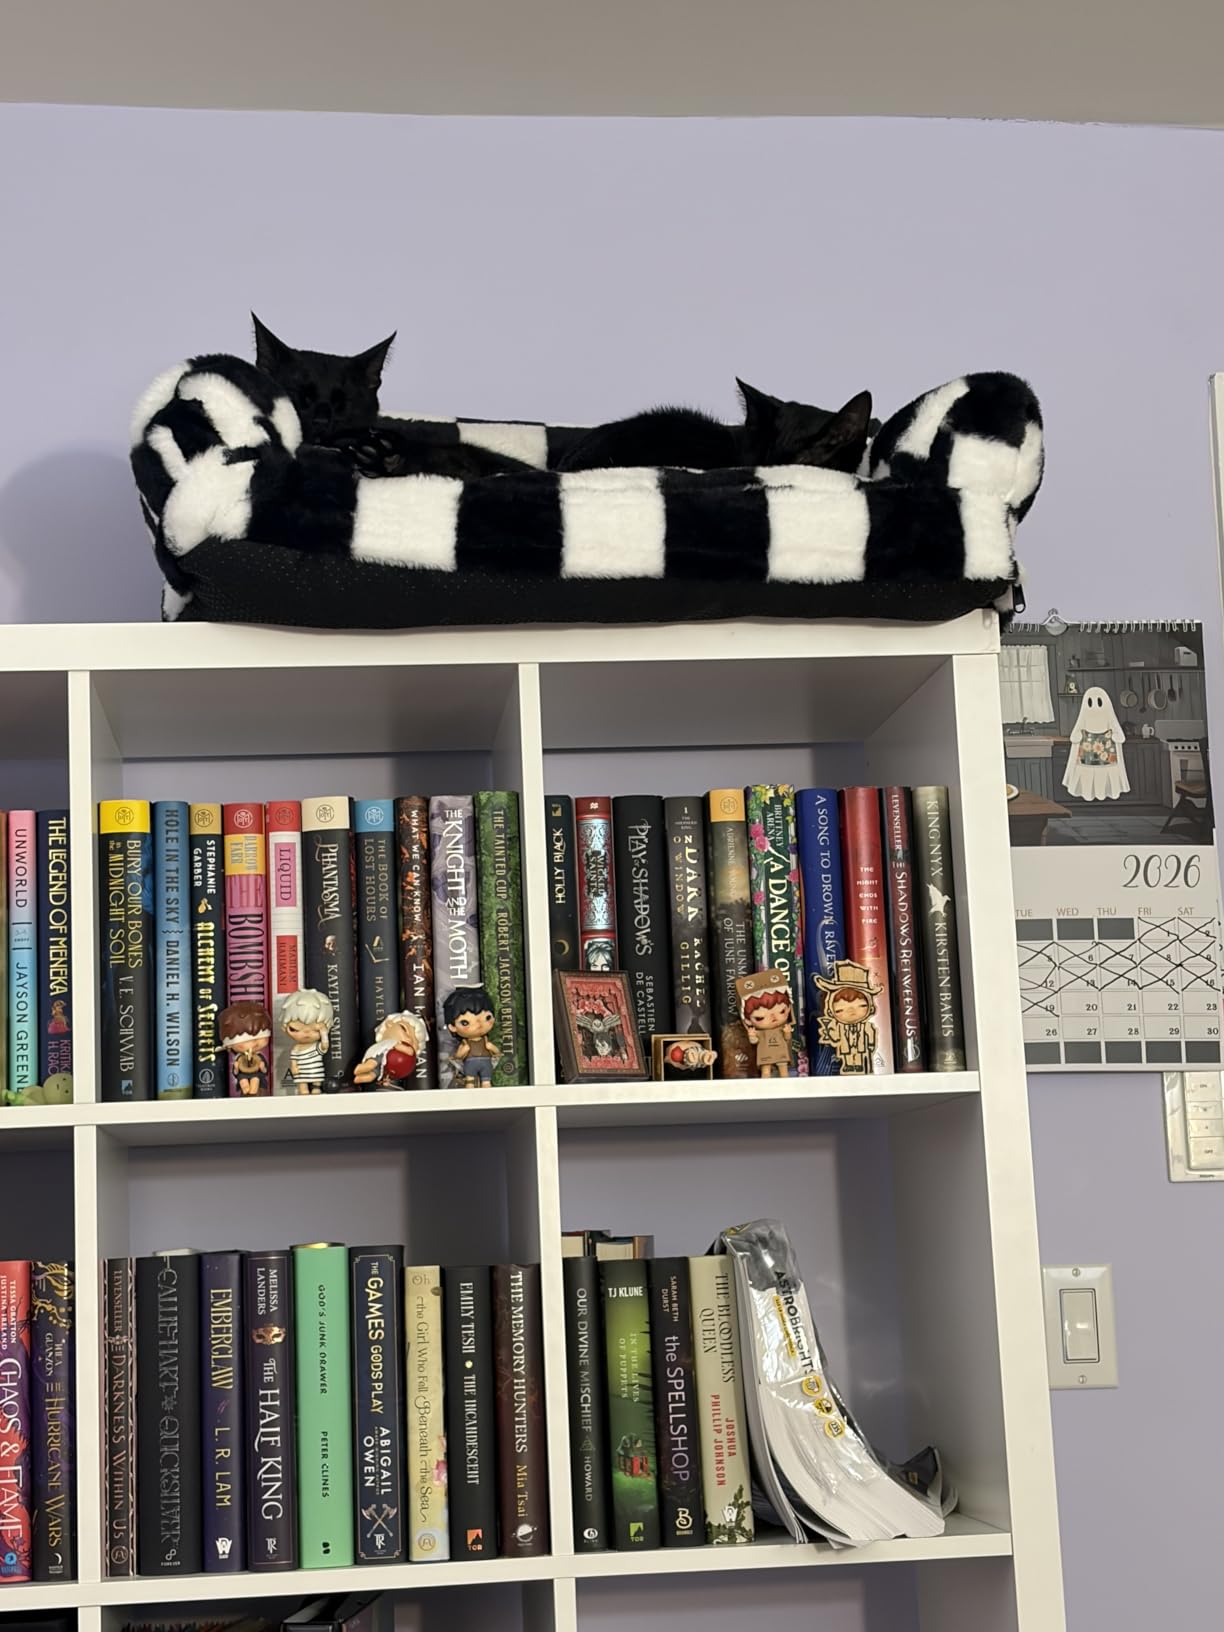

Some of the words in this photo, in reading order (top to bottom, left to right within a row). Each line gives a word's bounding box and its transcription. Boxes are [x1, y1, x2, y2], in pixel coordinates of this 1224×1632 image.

[444, 809, 463, 819] THE
[493, 810, 504, 829] THE
[815, 795, 827, 805] A
[927, 800, 941, 839] KING
[48, 817, 66, 846] THE
[164, 809, 179, 844] HOLE
[410, 811, 419, 839] WHAT
[628, 819, 652, 865] PLAY
[766, 812, 775, 841] ARENA
[774, 804, 784, 847] BRITTNEY
[816, 808, 830, 846] SONG
[892, 794, 903, 851] LEVENSELLER
[127, 840, 142, 877] BURY
[166, 850, 179, 862] IN
[364, 839, 375, 871] LOST
[378, 840, 386, 859] THE
[412, 845, 420, 859] WE
[442, 820, 466, 895] KNIGHT
[494, 833, 507, 876] TAINTED
[553, 827, 566, 863] BLACK
[820, 851, 832, 869] TO
[930, 844, 944, 876] NYX
[15, 829, 27, 908] UNWORLD
[48, 849, 67, 905] LEGEND
[166, 868, 179, 893] THE
[193, 848, 202, 887] GARBER
[206, 840, 216, 894] STEPHANIE
[279, 848, 292, 901] LIQUID
[316, 838, 342, 926] PHANTASMA
[378, 863, 389, 901] BOOK
[554, 867, 566, 904] HOLLY
[674, 852, 685, 915] WINDOW
[770, 861, 784, 873] A
[1122, 854, 1201, 888] 2026
[109, 854, 124, 923] MIDNIGHT
[128, 882, 142, 915] OUR
[365, 876, 376, 922] HOURS
[413, 891, 421, 922] KNOW
[496, 880, 508, 900] CUP
[821, 874, 834, 925] DROWN
[896, 871, 912, 946] SHADOWS
[49, 909, 67, 934] OF
[166, 898, 180, 924] SKY
[379, 906, 388, 919] OF
[632, 864, 653, 956] SHADOWS
[723, 918, 733, 933] OF
[768, 878, 791, 952] DANCE
[1015, 909, 1032, 917] TUE
[1056, 908, 1079, 916] WED
[1096, 907, 1117, 915] THU
[1138, 907, 1151, 915] FRI
[1177, 907, 1194, 915] SAT
[110, 929, 125, 968] SOIL
[128, 920, 142, 968] BONES
[448, 919, 469, 979] MOTH
[498, 912, 510, 952] ROBERT
[724, 938, 736, 963] JUNE
[735, 922, 746, 943] THE
[49, 937, 68, 996] MENEKA
[166, 940, 180, 988] DANIEL
[196, 921, 215, 984] ALCHEMY
[935, 922, 951, 988] KIRSTEN
[16, 962, 28, 1023] JAYSON
[413, 963, 426, 997] IAN
[500, 957, 512, 1005] JACKSON
[635, 972, 644, 986] DE
[680, 942, 692, 1004] GILLIG
[726, 969, 738, 1015] FARROW
[899, 949, 913, 1015] BETWEEN
[166, 993, 180, 1007] H.
[199, 988, 212, 1000] OF
[375, 976, 385, 1021] HAYLEY
[645, 975, 656, 1032] SEBASTIEN
[198, 1003, 218, 1062] SECRETS
[501, 1008, 514, 1055] BENNETT
[904, 1018, 918, 1039] US
[939, 993, 955, 1037] BAKIS
[120, 1005, 134, 1072] SCHWAB
[166, 1012, 180, 1067] WILSON
[331, 1017, 342, 1060] SMITH
[370, 1262, 379, 1274] THE
[510, 1271, 524, 1303] THE
[670, 1276, 678, 1298] SARAH
[715, 1273, 730, 1299] THE
[113, 1270, 123, 1332] LEVENSELLER
[157, 1268, 179, 1338] CALLIE
[256, 1267, 266, 1315] LANDERS
[269, 1269, 278, 1313] MELISSA
[318, 1284, 327, 1318] GOD'S
[364, 1277, 385, 1341] GAMES
[460, 1283, 475, 1319] EMILY
[576, 1288, 589, 1317] OUR
[608, 1287, 617, 1298] TJ
[619, 1286, 643, 1297] KLUNE
[671, 1301, 679, 1322] BETH
[699, 1307, 718, 1353] QUEEN
[210, 1288, 233, 1390] EMBERCLAW
[318, 1321, 327, 1348] JUNK
[416, 1321, 430, 1344] Girl
[462, 1323, 476, 1353] TESH
[511, 1306, 526, 1374] MEMORY
[578, 1321, 589, 1366] DIVINE
[664, 1336, 681, 1362] the
[717, 1304, 736, 1383] BLOODLESS
[45, 1332, 54, 1376] GUANZON
[158, 1340, 180, 1395] HART
[263, 1357, 277, 1383] THE
[319, 1352, 328, 1394] DRAWER
[370, 1345, 383, 1380] GODS
[417, 1348, 428, 1373] Who
[0, 1358, 21, 1431] CHAOS
[418, 1376, 429, 1396] Fell
[464, 1374, 477, 1395] THE
[619, 1353, 628, 1398] PUPPETS
[112, 1355, 126, 1444] DARKNESS
[370, 1382, 385, 1414] PLAY
[514, 1378, 528, 1453] HUNTERS
[580, 1371, 592, 1432] MISCHIEF
[710, 1394, 722, 1434] PHILLIP
[215, 1427, 231, 1442] L.
[254, 1388, 281, 1453] HALF
[415, 1395, 433, 1457] Beneath
[667, 1367, 690, 1481] SPELLSHOP
[725, 1417, 737, 1457] JOSHUA
[0, 1441, 19, 1456] &
[45, 1397, 66, 1490] HURRICANE
[215, 1448, 231, 1464] R.
[321, 1431, 329, 1459] PETER
[363, 1436, 376, 1487] OWEN
[379, 1426, 393, 1495] ABIGAIL
[465, 1400, 480, 1485] INCANDESCENT
[714, 1438, 726, 1487] JOHNSON
[112, 1450, 126, 1510] WITHIN
[159, 1415, 182, 1546] QUICKSILVER
[215, 1472, 232, 1507] LAM
[256, 1456, 284, 1520] KING
[321, 1463, 330, 1498] CLINES
[516, 1465, 528, 1488] Mia
[584, 1456, 593, 1501] HOWARD
[0, 1464, 23, 1538] FLAME
[419, 1486, 433, 1523] Sea
[517, 1491, 529, 1517] Tsai
[44, 1495, 65, 1548] WARS
